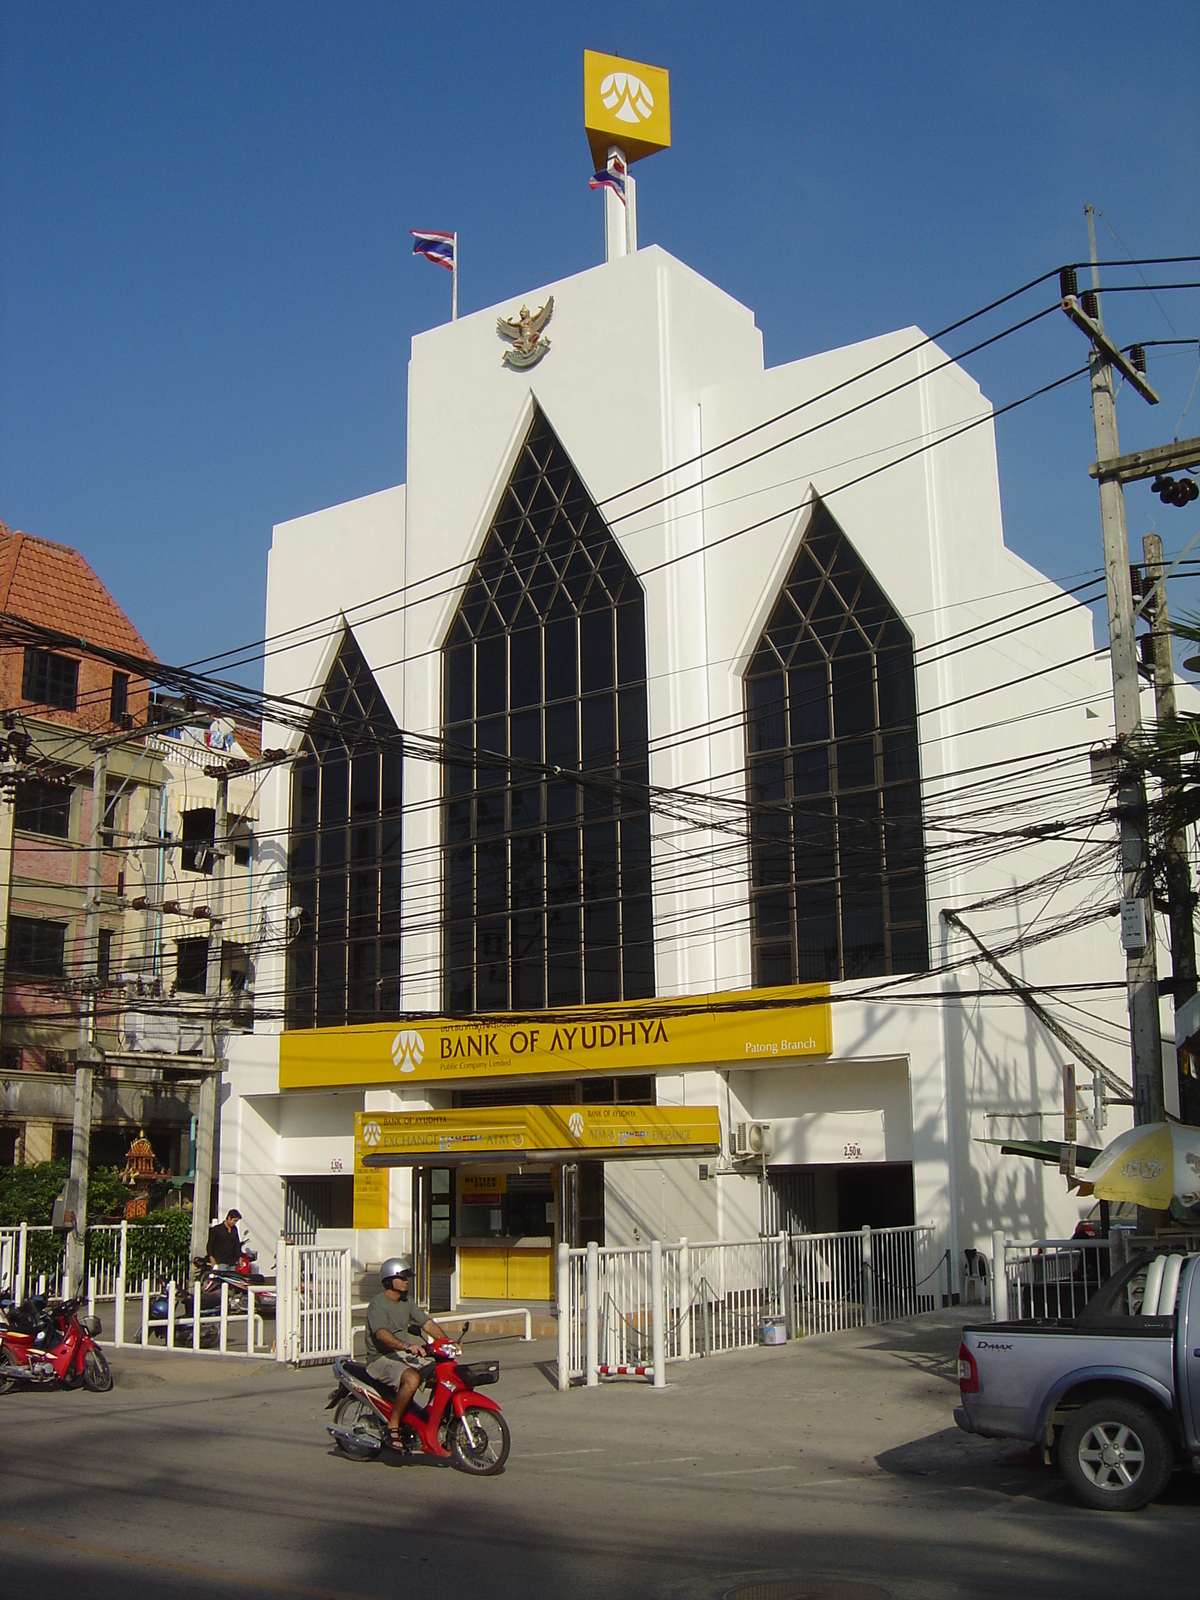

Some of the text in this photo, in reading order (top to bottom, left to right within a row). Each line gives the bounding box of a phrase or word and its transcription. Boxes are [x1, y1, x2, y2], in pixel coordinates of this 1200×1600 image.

[440, 1033, 499, 1059] BANK
[509, 1030, 540, 1054] OF
[550, 1019, 669, 1051] AYUDHYA
[745, 1037, 816, 1054] Patong Branch
[440, 1058, 511, 1070] Public Company Limited
[404, 1117, 413, 1125] OF
[415, 1116, 447, 1124] AYUDHYA
[384, 1134, 438, 1147] EXCHANGE
[486, 1134, 509, 1145] ATM
[589, 1130, 606, 1140] ATM
[652, 1129, 691, 1141] EXCHANGE
